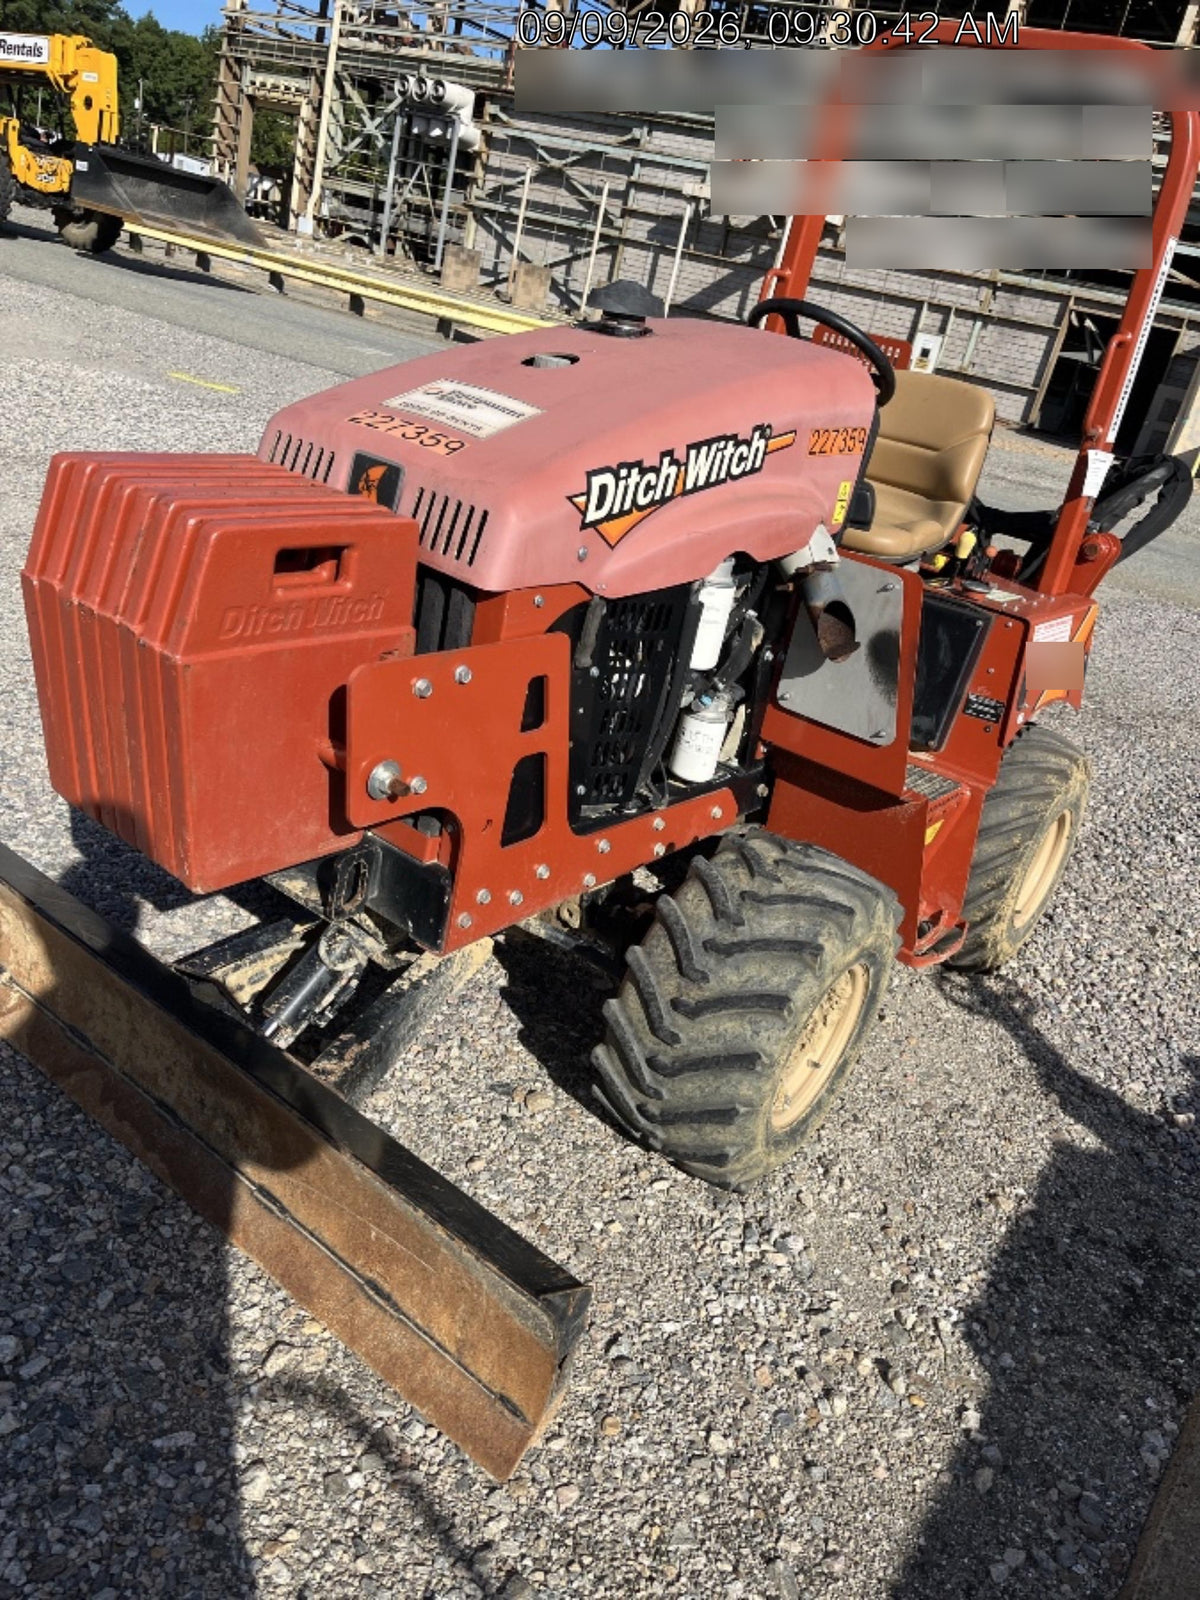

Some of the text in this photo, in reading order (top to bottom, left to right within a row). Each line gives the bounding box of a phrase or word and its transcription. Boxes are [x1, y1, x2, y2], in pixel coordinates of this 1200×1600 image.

[0, 38, 43, 58] Rentals
[347, 411, 466, 456] 227359
[808, 427, 867, 456] 227359
[582, 429, 771, 526] Ditch Witch
[219, 593, 386, 640] Ditch Witch
